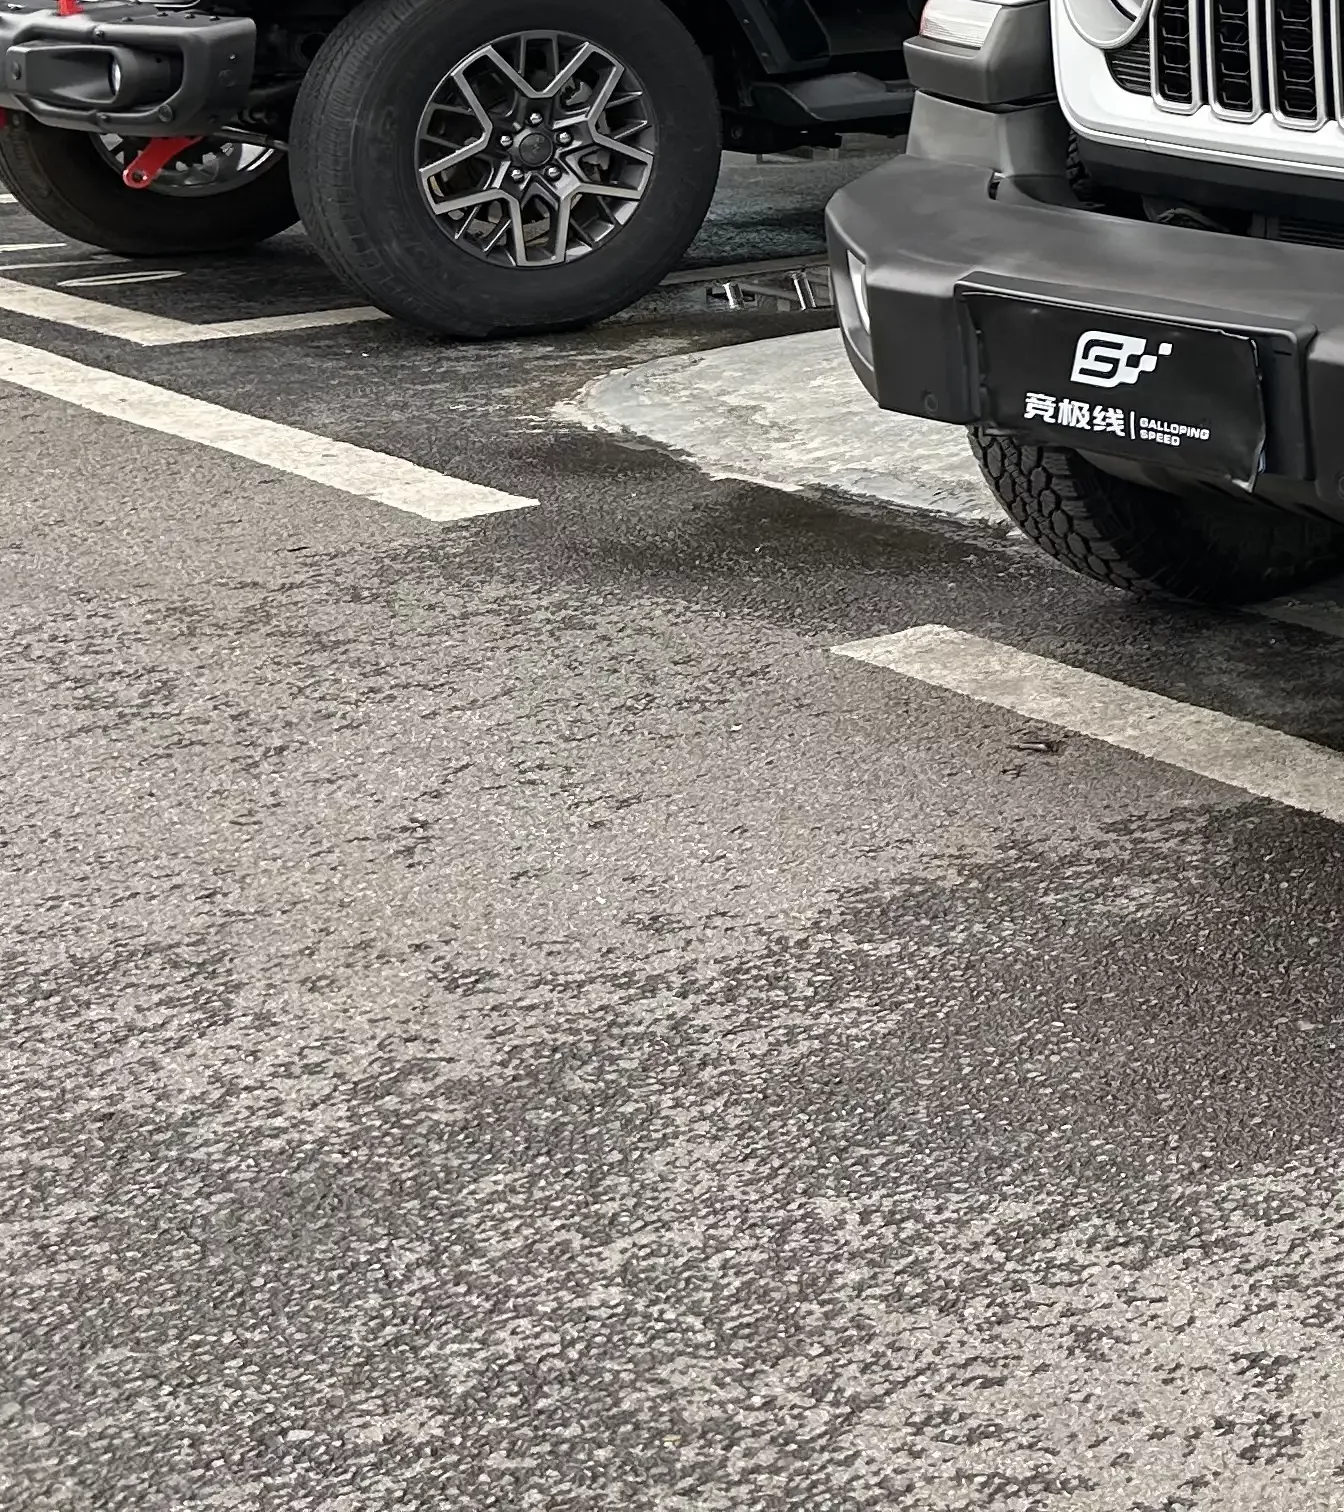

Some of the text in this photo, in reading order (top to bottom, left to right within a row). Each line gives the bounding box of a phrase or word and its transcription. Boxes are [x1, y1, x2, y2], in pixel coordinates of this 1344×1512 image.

[1023, 392, 1126, 437] 竞极线
[1138, 417, 1211, 440] GALLOPING
[1138, 429, 1181, 447] SPEED
